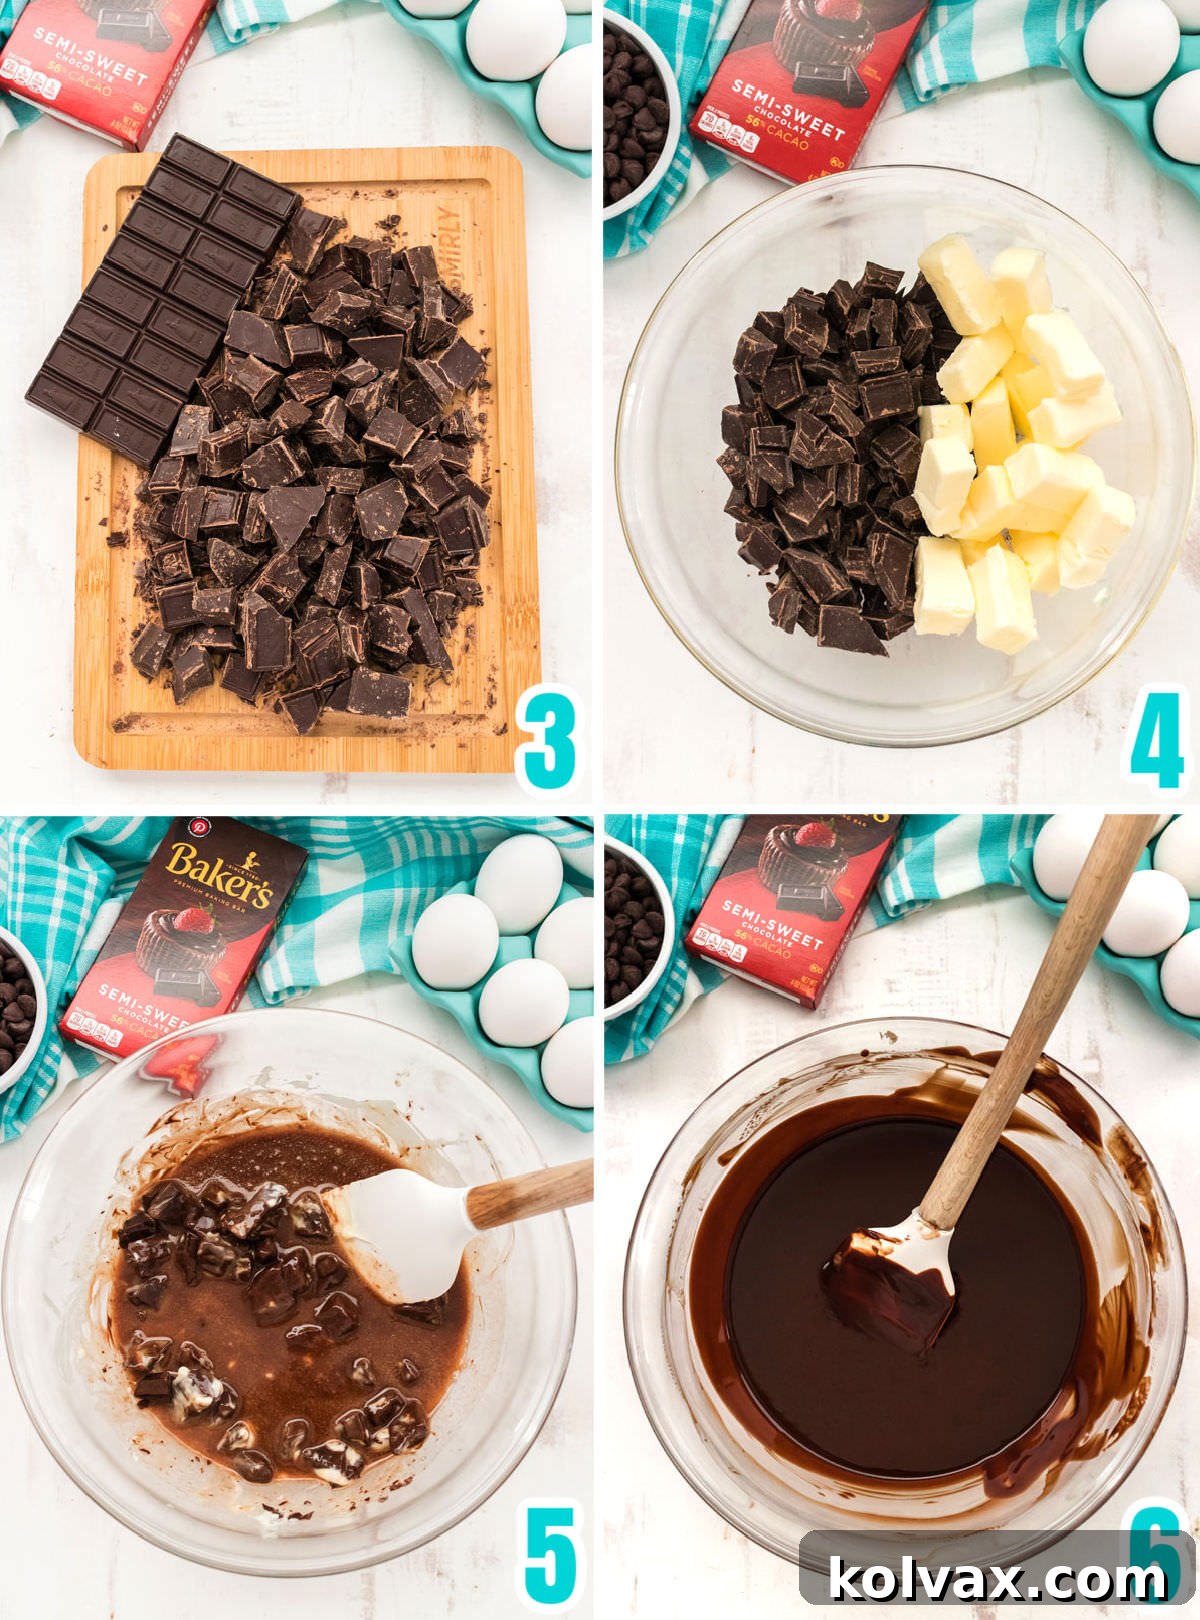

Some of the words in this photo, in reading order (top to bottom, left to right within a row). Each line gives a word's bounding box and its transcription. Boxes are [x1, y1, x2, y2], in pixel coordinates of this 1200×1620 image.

[33, 27, 148, 86] SEMI-SWEET
[55, 51, 114, 83] CHOCOLATE
[67, 70, 113, 97] CACAO
[731, 78, 845, 141] SEMI-SWEET
[753, 105, 812, 138] CHOCOLATE
[766, 124, 809, 151] CACAO
[231, 904, 246, 914] BAR
[722, 900, 824, 951] SEMI-SWEET
[742, 921, 793, 948] CHOCOLATE
[753, 938, 792, 960] CACAO
[98, 983, 190, 1030] SEMI-SWEE
[118, 1006, 170, 1033] CHOCOLATE
[128, 1021, 159, 1041] CACA
